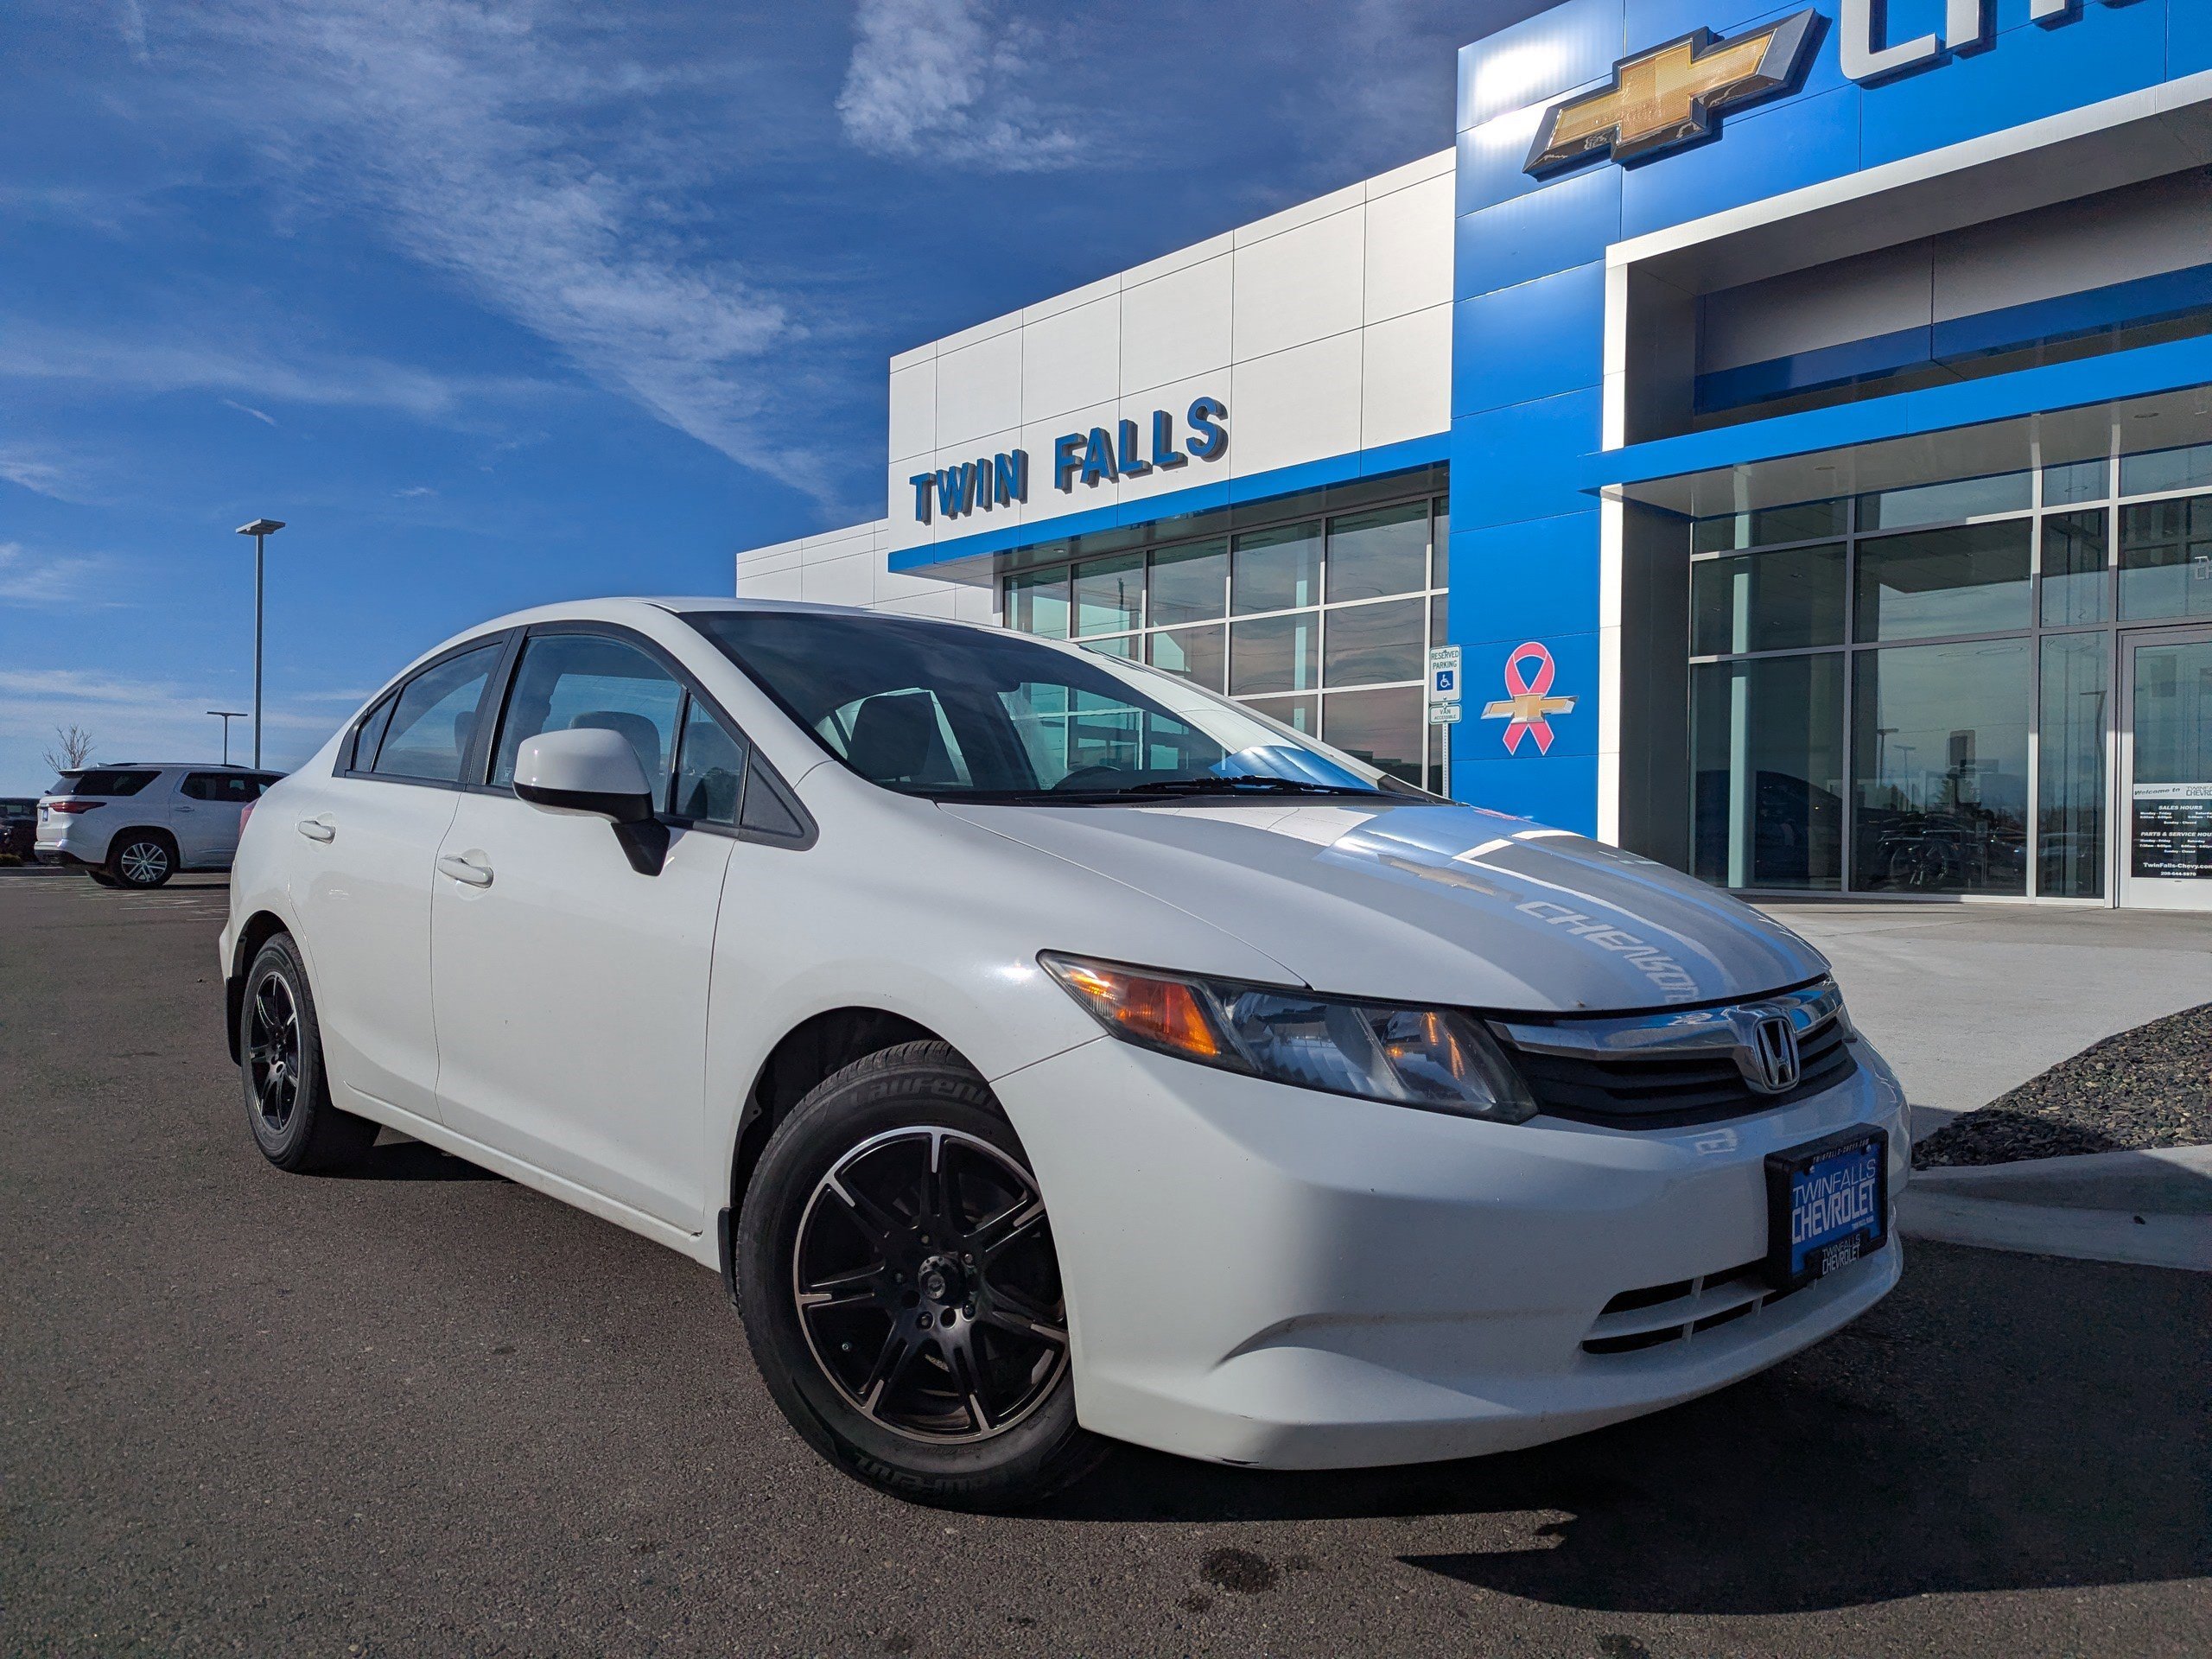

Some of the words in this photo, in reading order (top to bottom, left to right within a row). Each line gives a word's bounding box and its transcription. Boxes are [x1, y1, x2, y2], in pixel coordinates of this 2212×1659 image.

[909, 448, 1027, 524] TWIN
[1055, 397, 1227, 493] FALLS
[1431, 650, 1459, 660] RESERVED
[1432, 660, 1458, 670] PARKING
[1792, 1158, 1876, 1208] TWINFALLS
[1791, 1178, 1876, 1245] CHEVROLET
[1822, 1233, 1861, 1257] TWINFALLS
[1822, 1244, 1860, 1276] CHEVROLET
